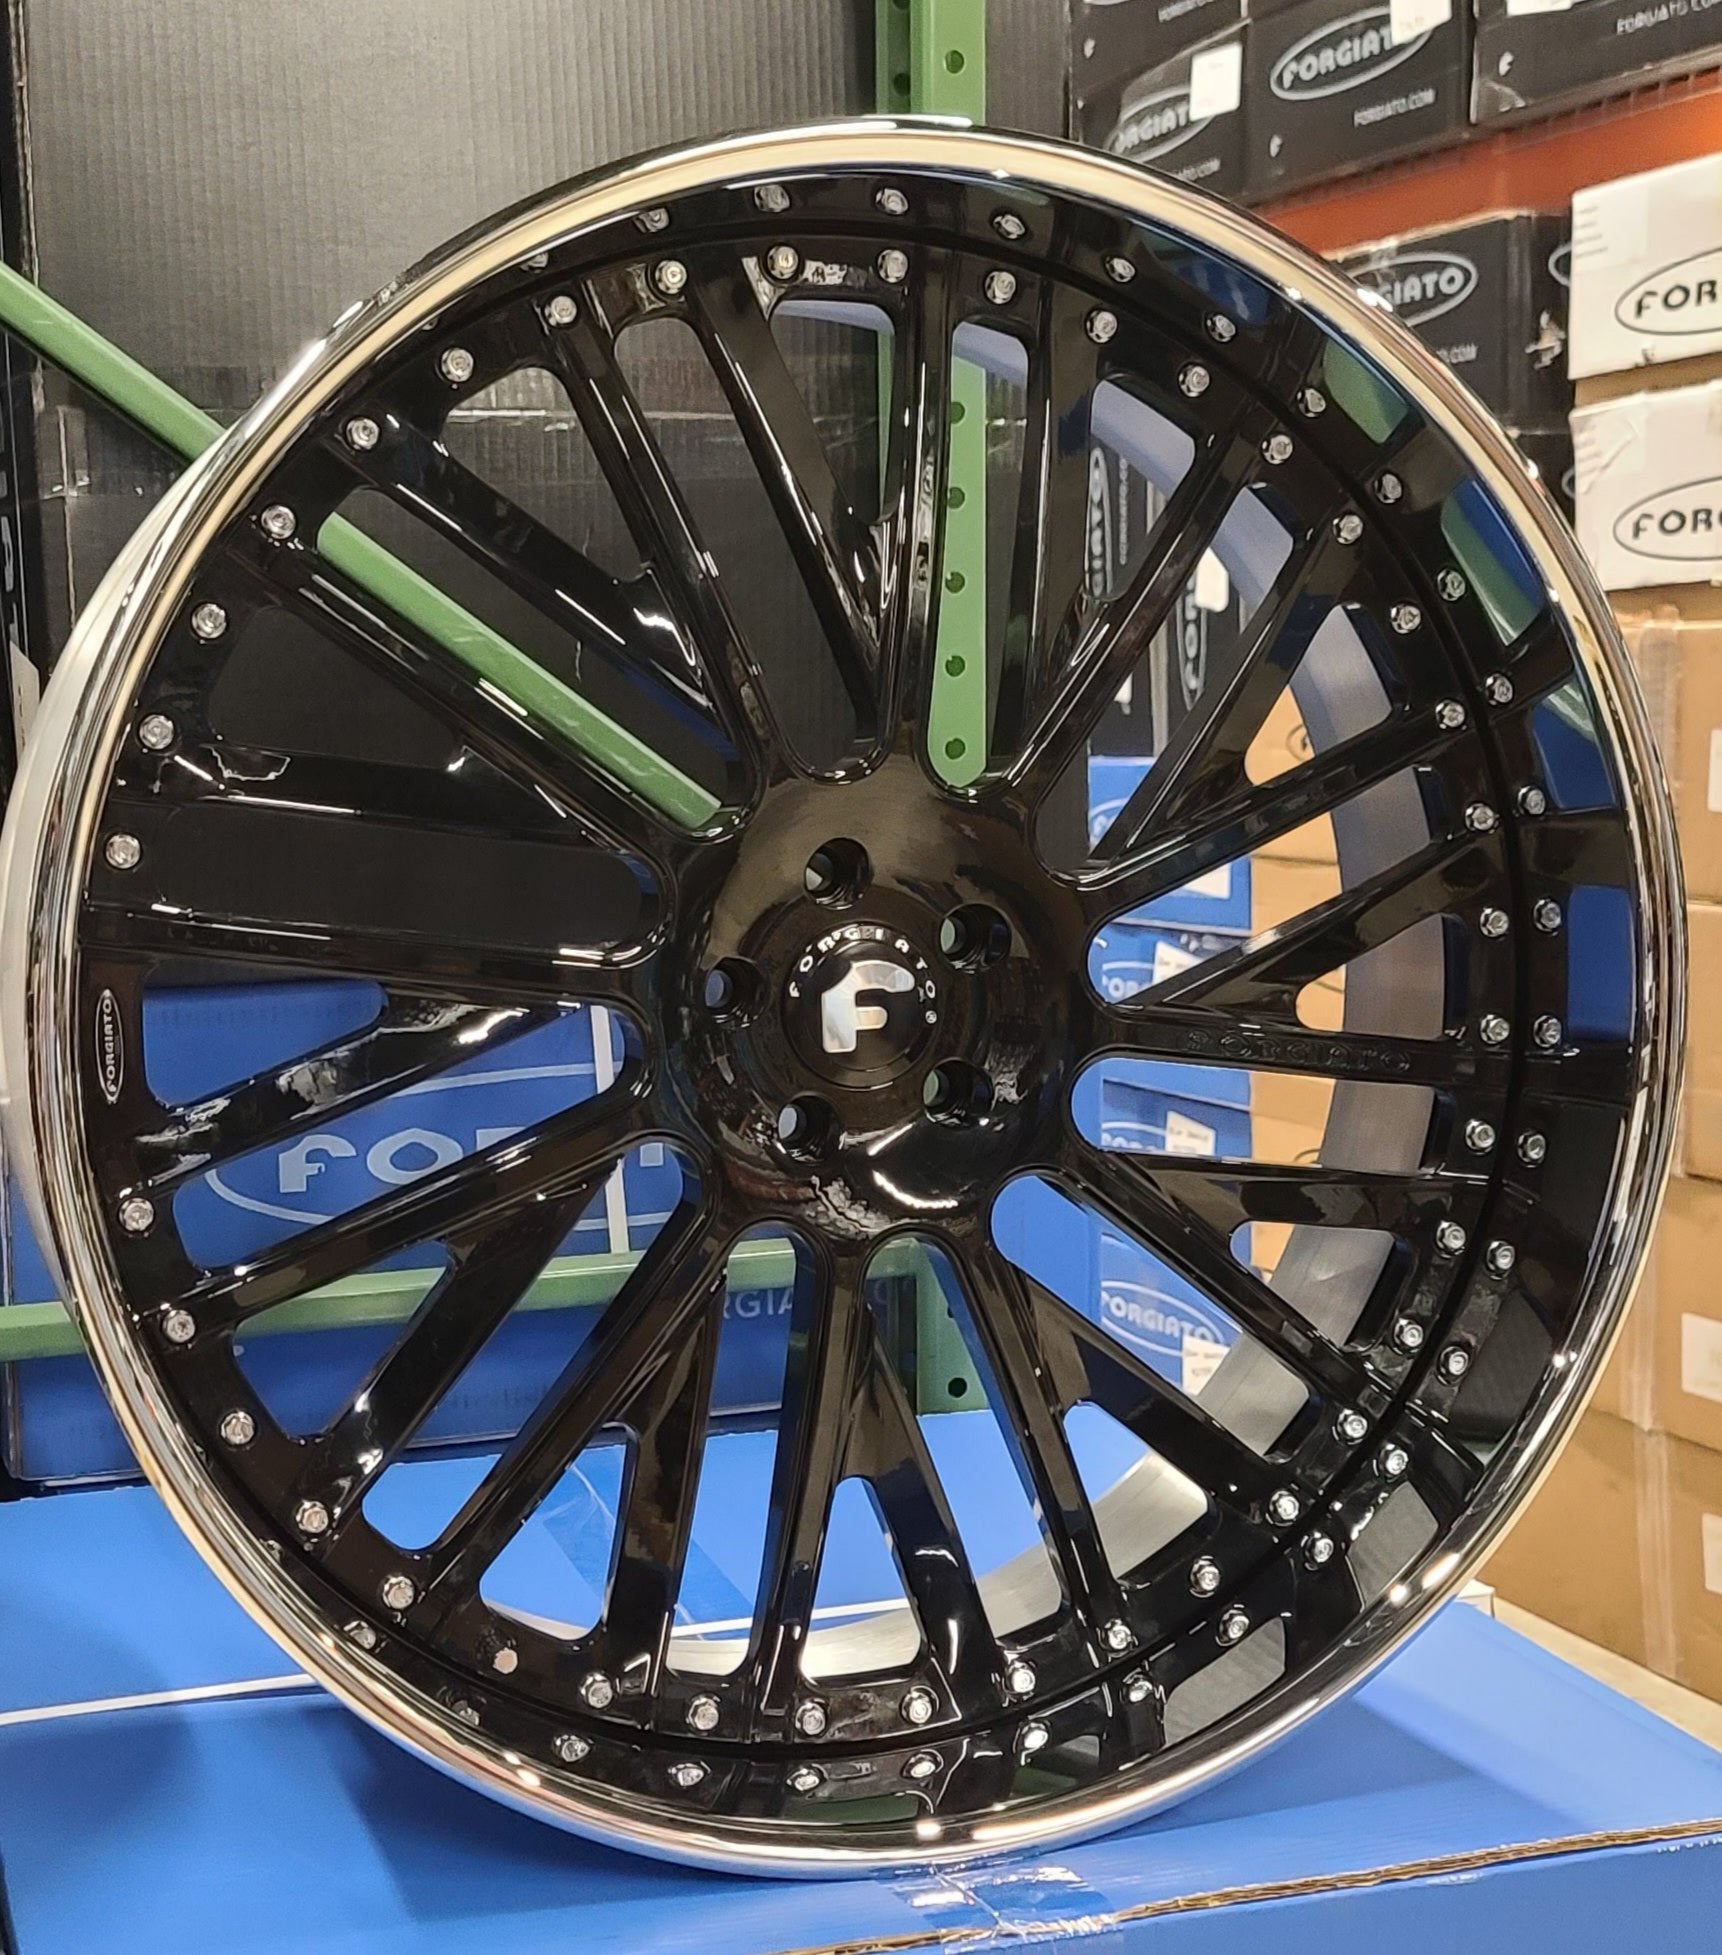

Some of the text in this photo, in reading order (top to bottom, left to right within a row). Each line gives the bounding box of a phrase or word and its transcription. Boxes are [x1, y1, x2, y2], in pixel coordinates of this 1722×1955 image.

[1282, 26, 1394, 90] FORGIAT
[1632, 507, 1722, 540] FOR
[102, 998, 118, 1093] FORGIATO
